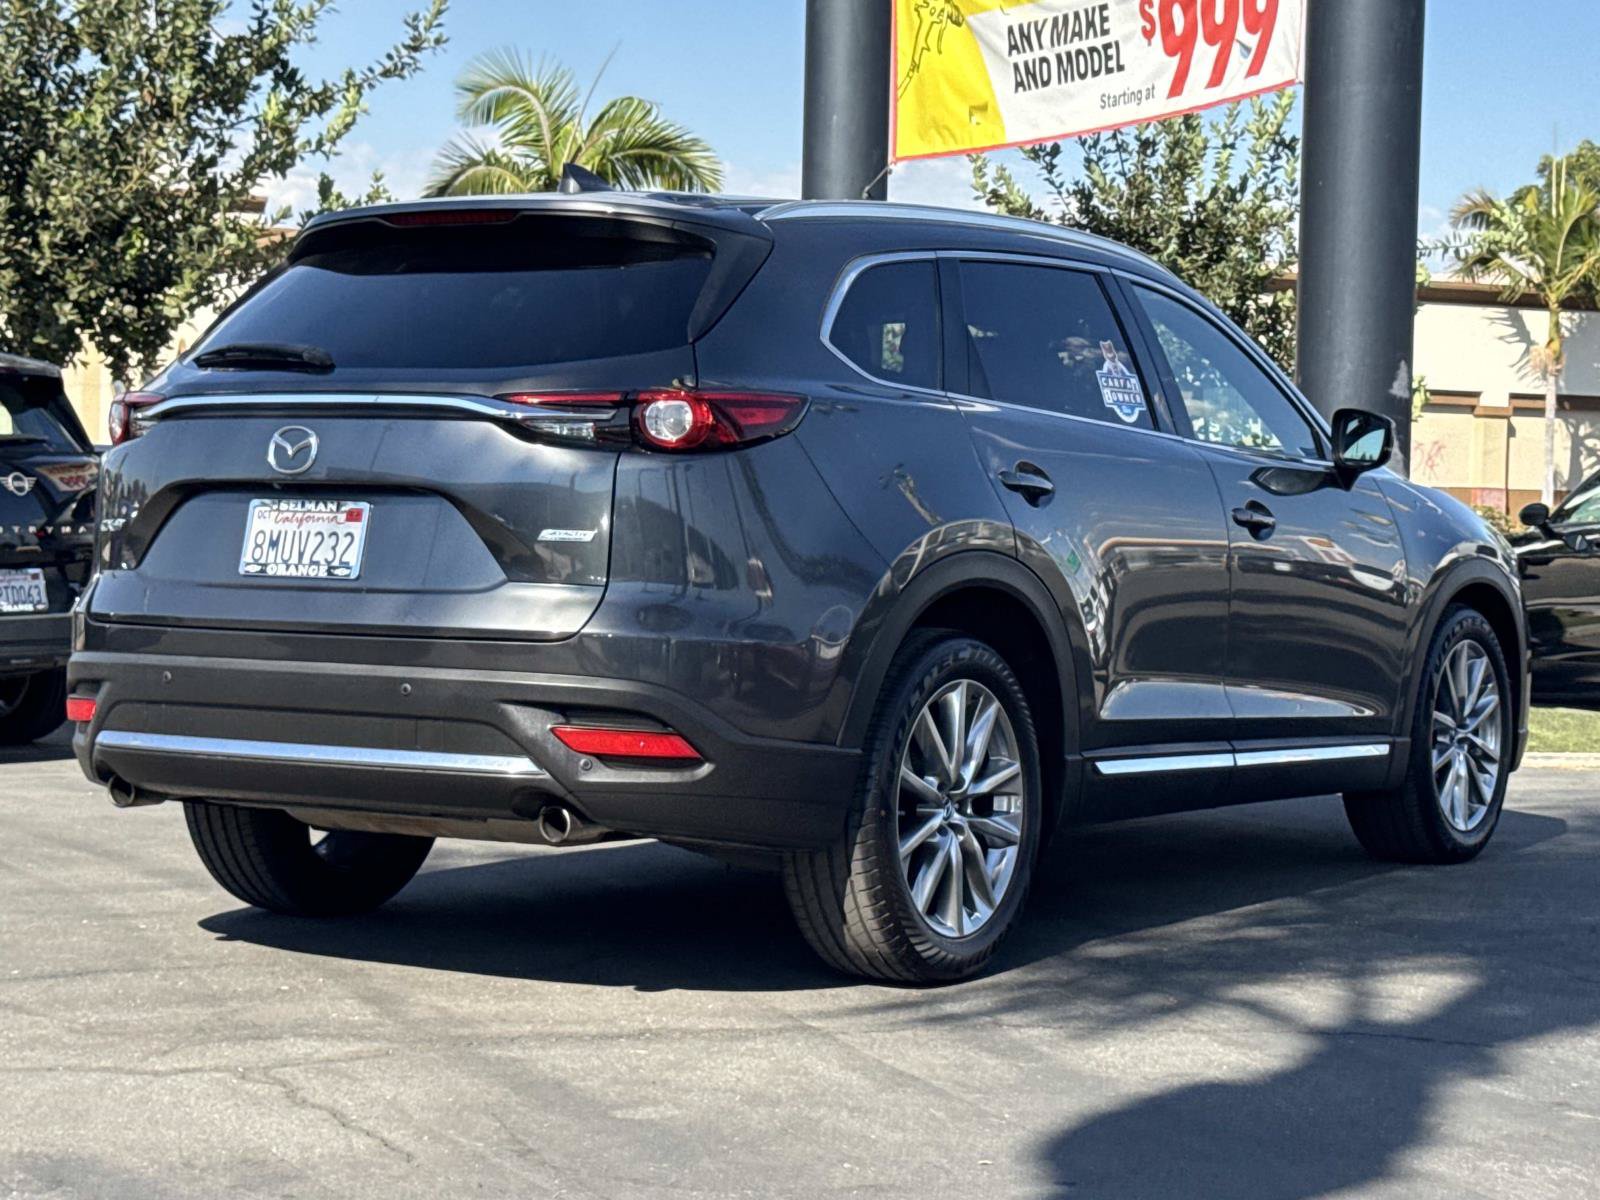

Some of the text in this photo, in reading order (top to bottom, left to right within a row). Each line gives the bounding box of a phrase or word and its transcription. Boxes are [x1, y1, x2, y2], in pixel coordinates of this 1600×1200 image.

[1008, 4, 1110, 57] ANY MAKE
[1013, 40, 1125, 93] AND MODEL
[1100, 83, 1156, 110] Starting at
[273, 510, 346, 529] California
[278, 500, 338, 512] SELMAN
[251, 530, 355, 566] 8MUV232
[266, 563, 329, 577] ORANGE
